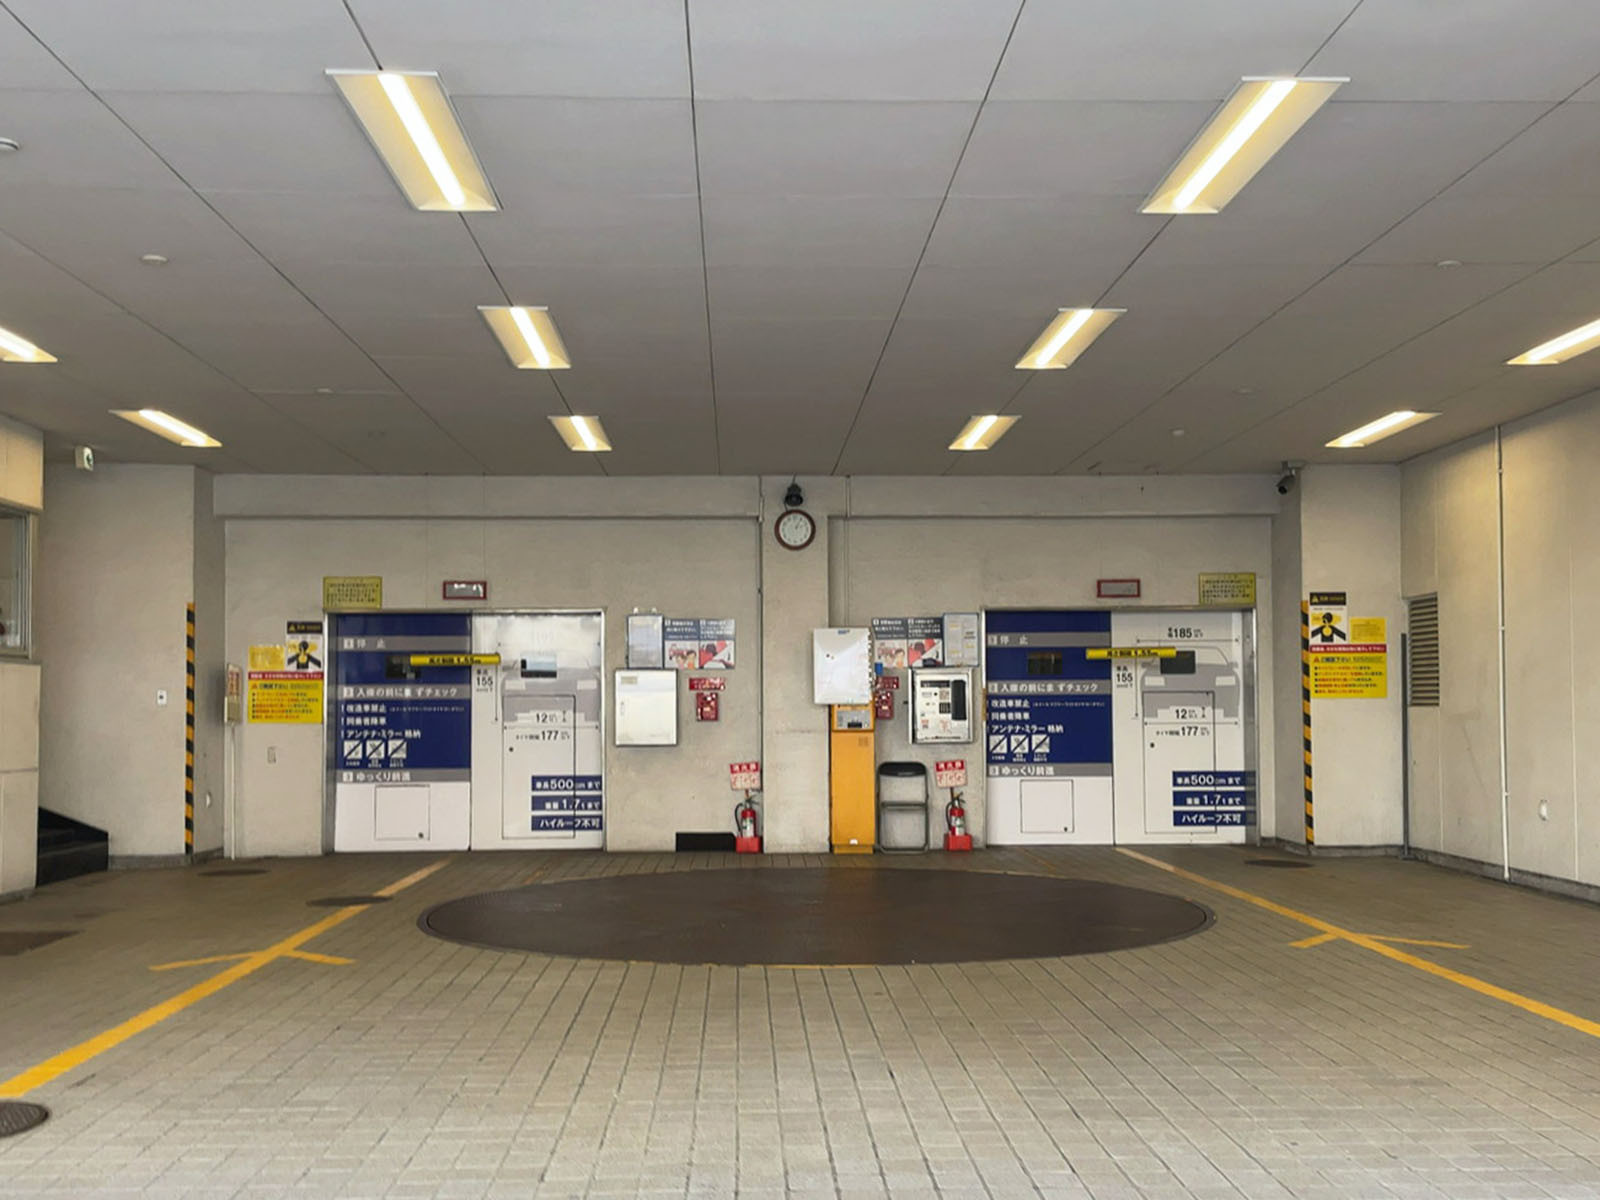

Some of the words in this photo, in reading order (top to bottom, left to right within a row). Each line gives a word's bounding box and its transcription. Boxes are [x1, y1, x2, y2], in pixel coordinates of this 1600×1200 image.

[1174, 628, 1192, 638] 185
[476, 677, 493, 686] 155
[1116, 673, 1133, 682] 155
[536, 713, 548, 723] 12
[1175, 709, 1187, 719] 12
[541, 731, 559, 740] 177
[1181, 726, 1198, 736] 177
[540, 818, 600, 828] ハイルーフ不可
[1182, 813, 1241, 823] ハイルーフ不可
